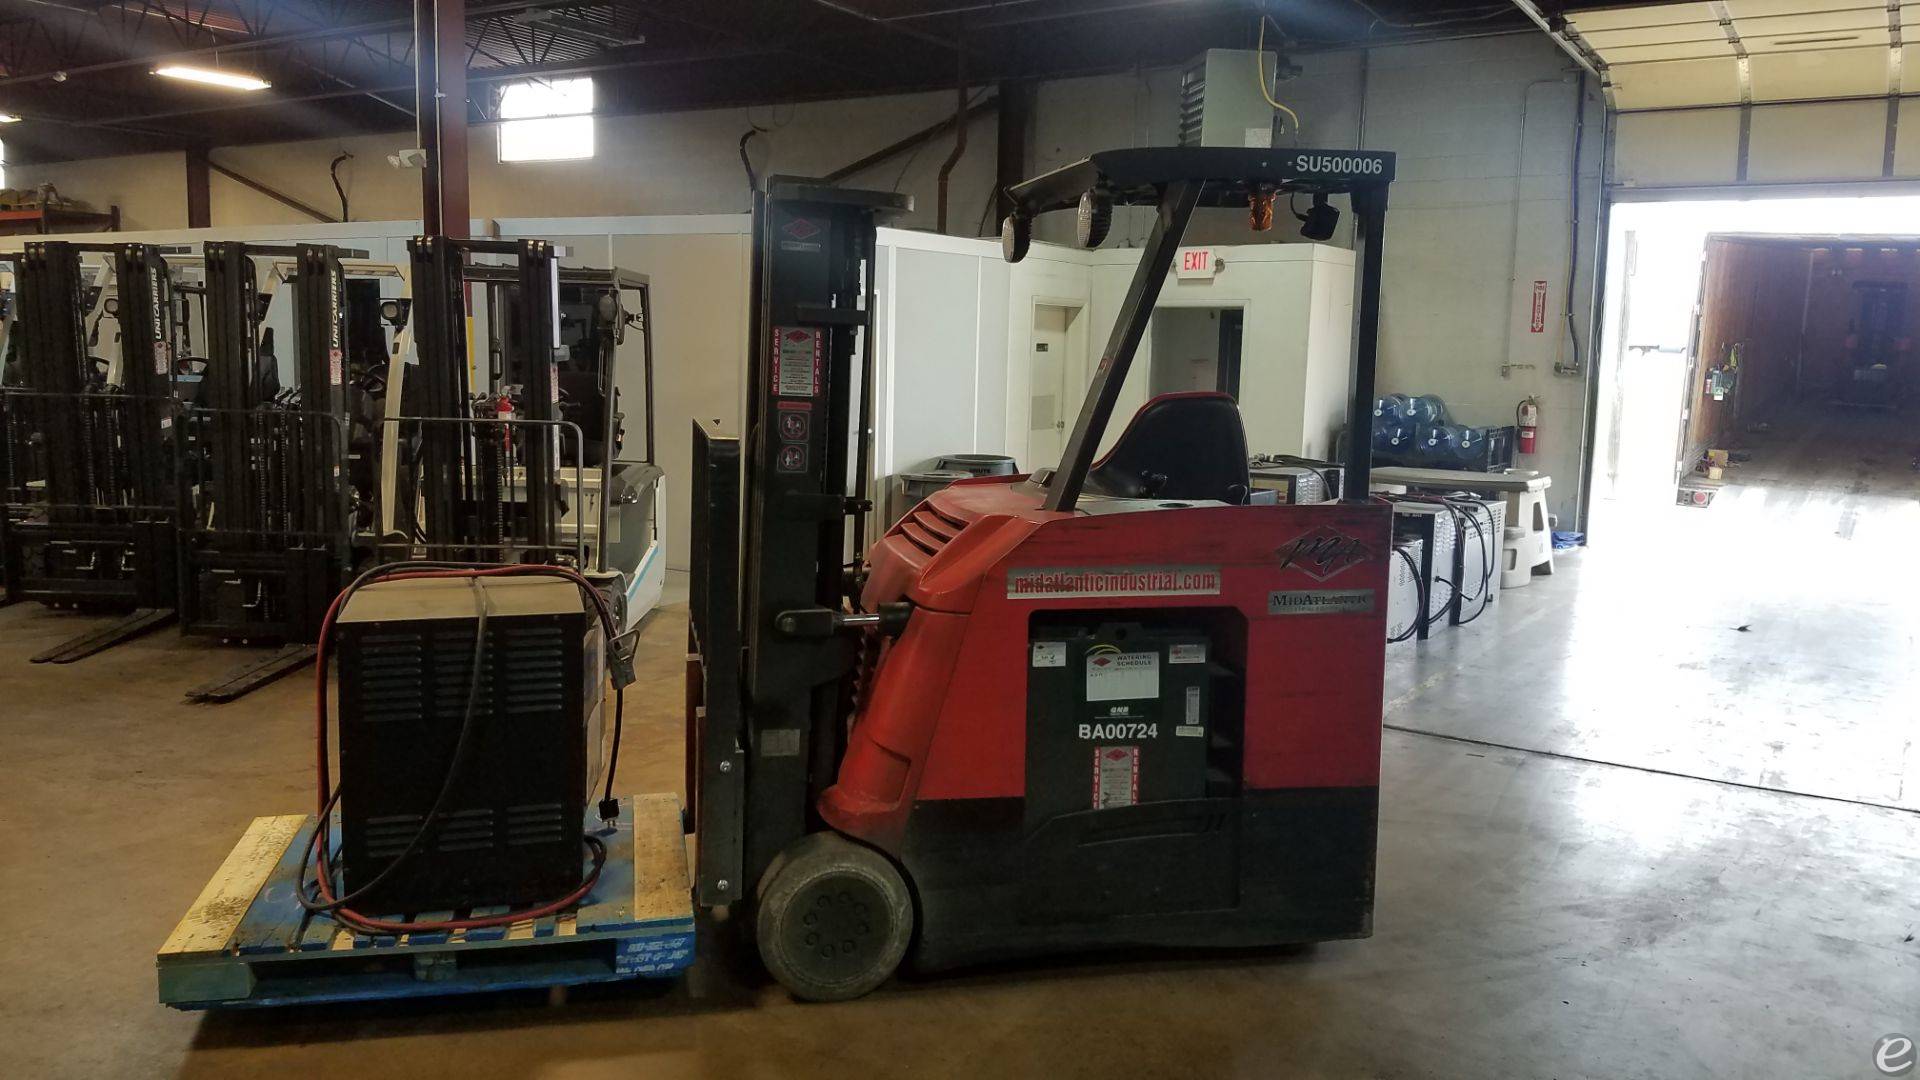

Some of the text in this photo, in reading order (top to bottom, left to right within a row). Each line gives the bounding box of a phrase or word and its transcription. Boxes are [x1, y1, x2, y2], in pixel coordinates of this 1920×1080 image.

[1296, 154, 1383, 174] SU500006
[1183, 251, 1208, 271] EXIT
[150, 266, 162, 340] UNICARRIERS
[330, 269, 339, 348] UNICARRIERS
[1014, 570, 1216, 594] midatlanticindustrial.com
[1078, 723, 1158, 740] BA00724
